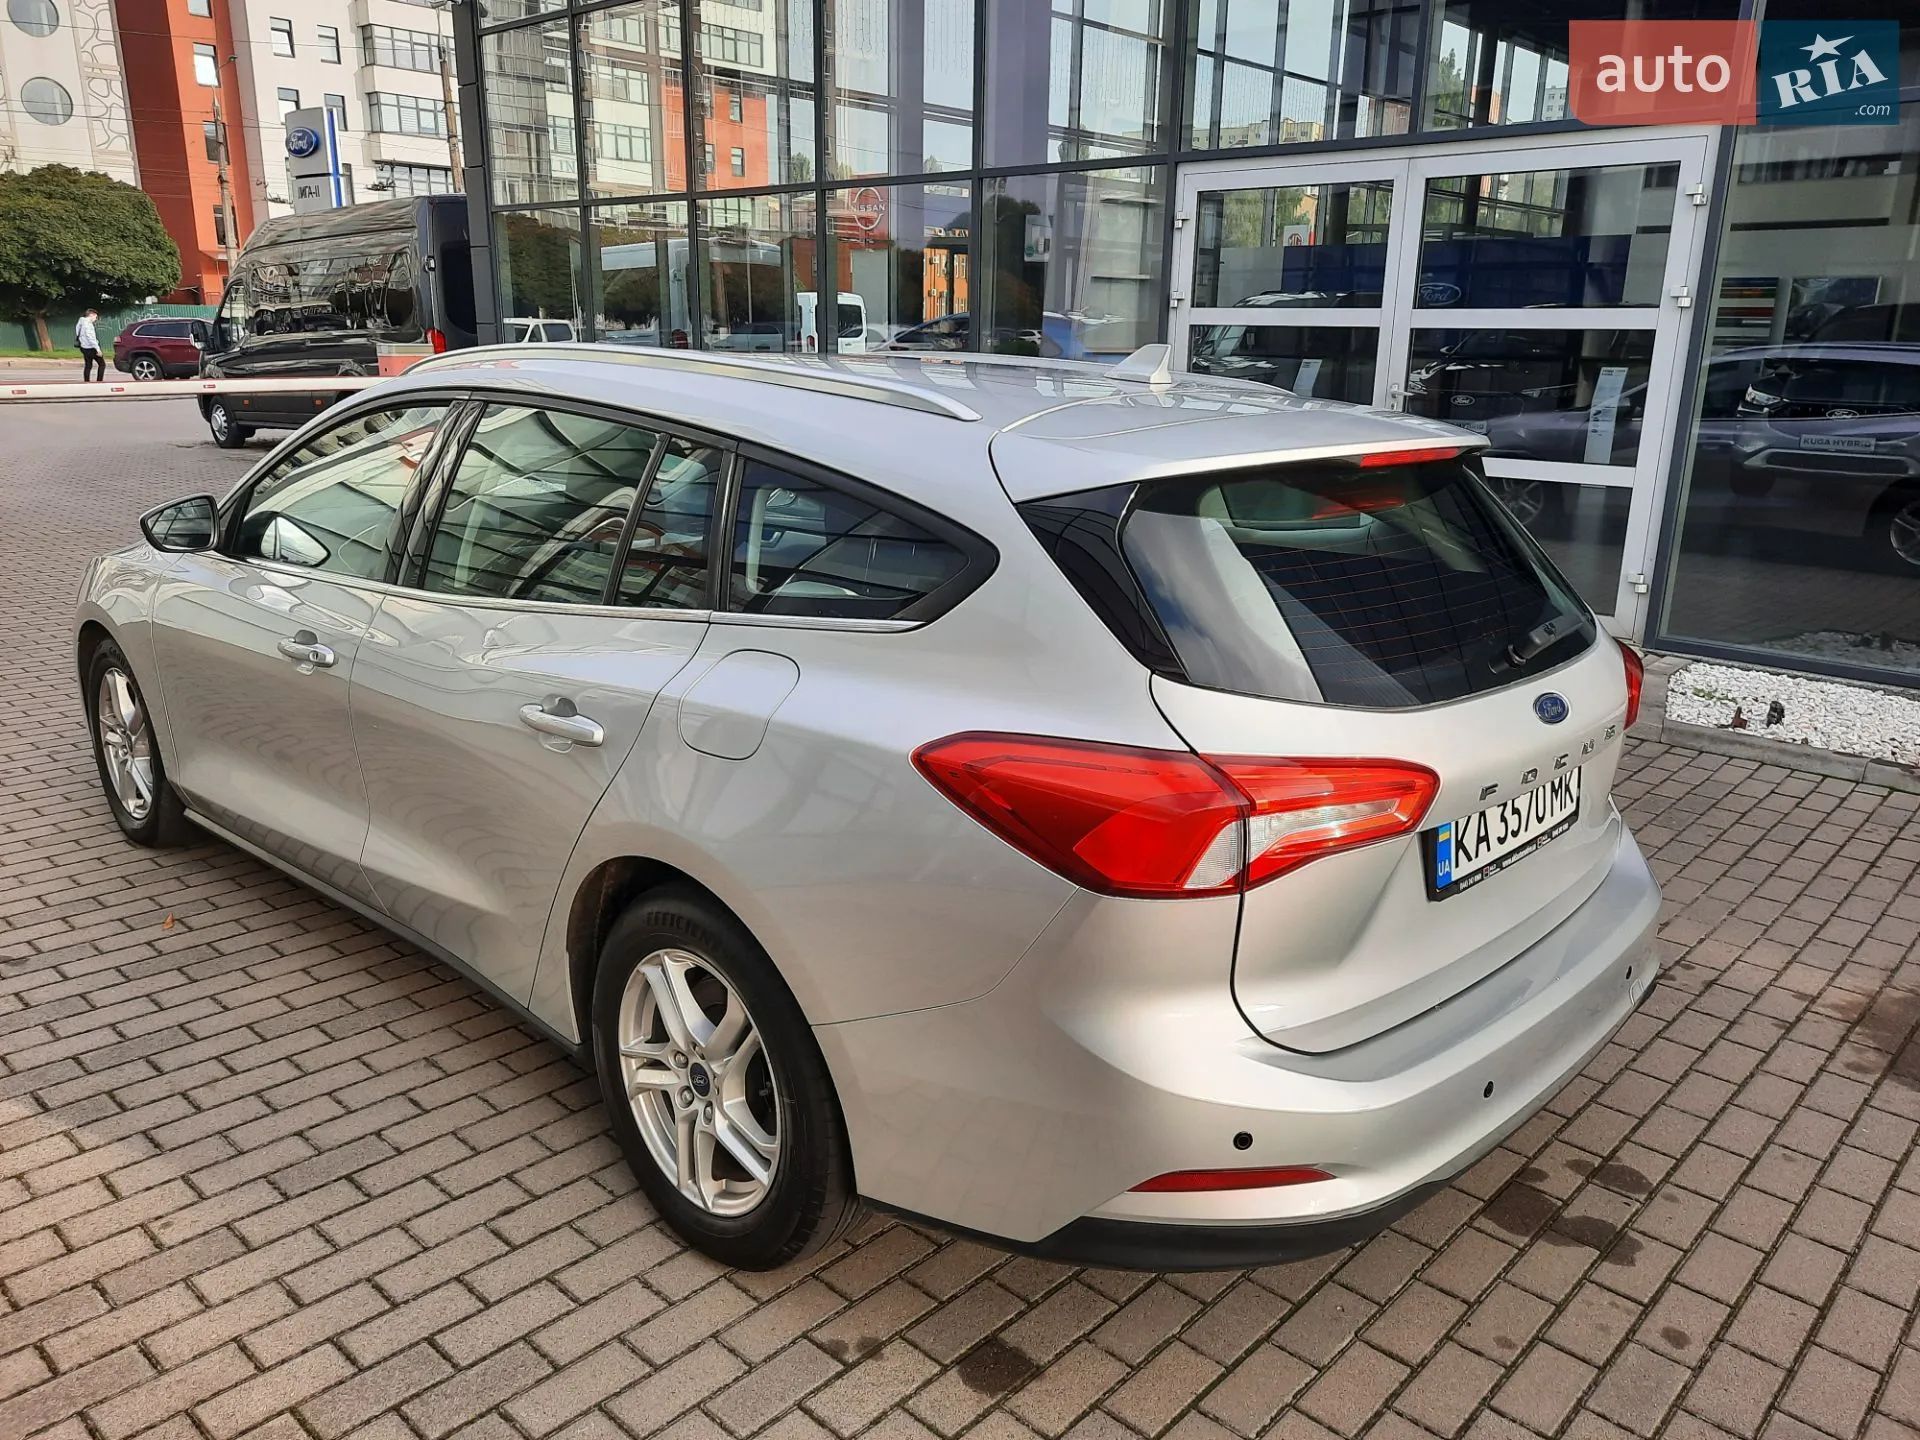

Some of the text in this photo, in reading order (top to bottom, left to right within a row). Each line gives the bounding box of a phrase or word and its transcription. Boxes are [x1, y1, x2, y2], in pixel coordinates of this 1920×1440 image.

[851, 204, 885, 212] NISSAN
[1421, 286, 1452, 301] Ford
[1833, 440, 1871, 448] HYBRID
[1479, 724, 1616, 801] FOCUS
[1454, 813, 1491, 869] KA
[1496, 784, 1546, 845] 3570
[1551, 769, 1575, 817] MK
[1438, 859, 1450, 877] UA
